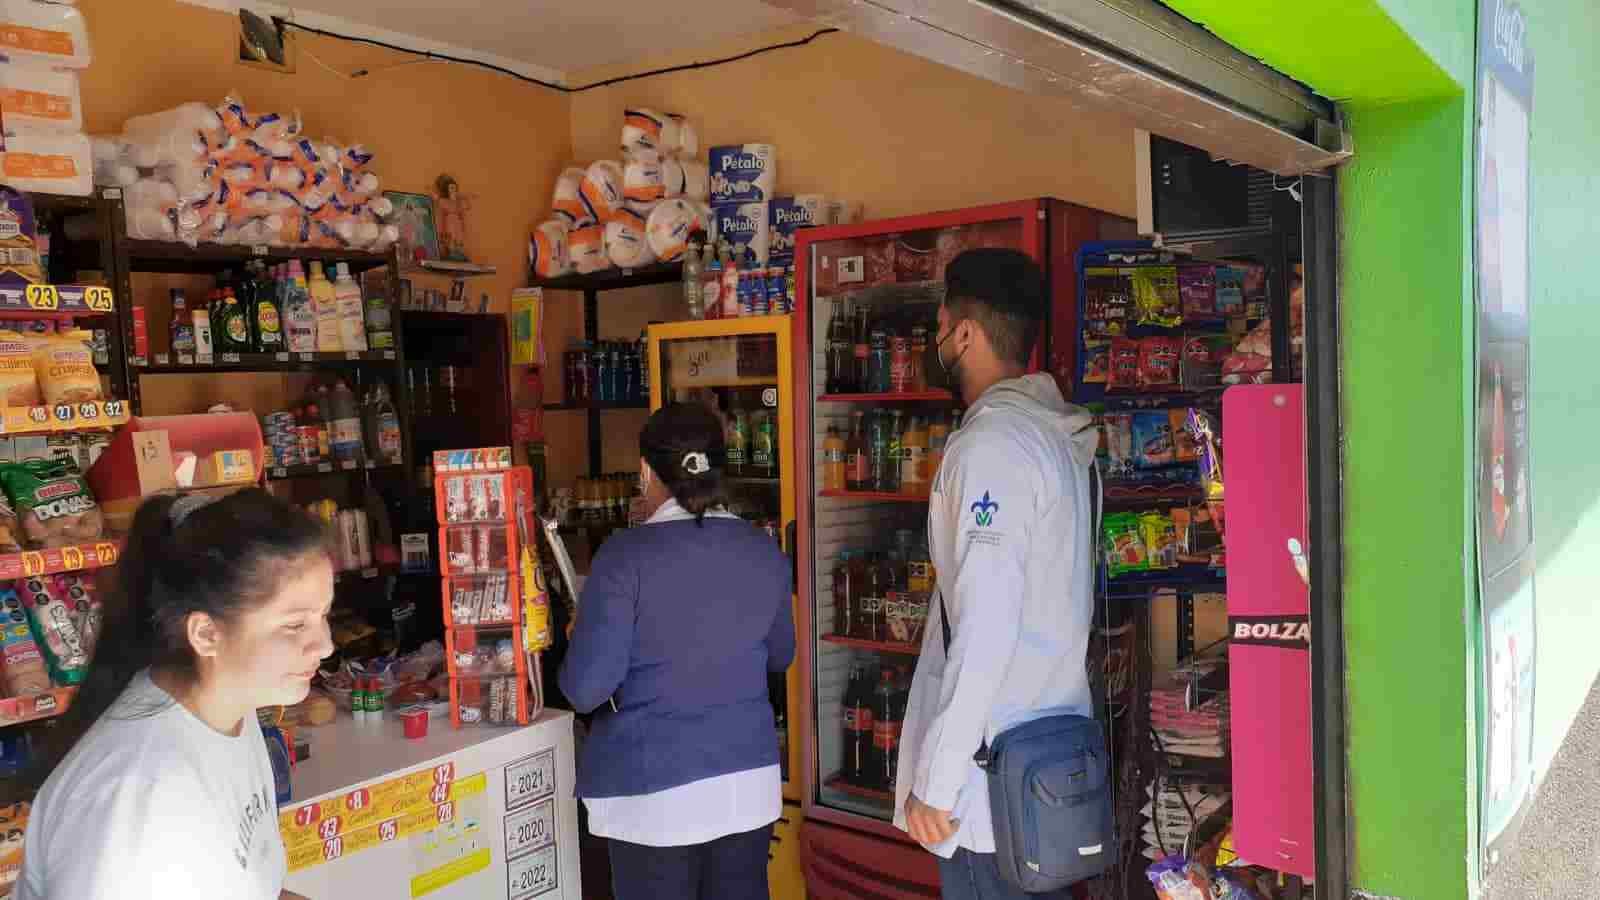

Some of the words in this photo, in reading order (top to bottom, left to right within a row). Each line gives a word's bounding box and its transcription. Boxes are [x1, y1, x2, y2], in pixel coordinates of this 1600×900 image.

[32, 286, 55, 307] 23
[90, 289, 112, 309] 25
[56, 405, 72, 420] 27
[105, 401, 121, 416] 32
[1234, 622, 1311, 641] BOLZA
[518, 768, 544, 794] 2021
[518, 818, 545, 844] 2020
[520, 864, 547, 890] 2022
